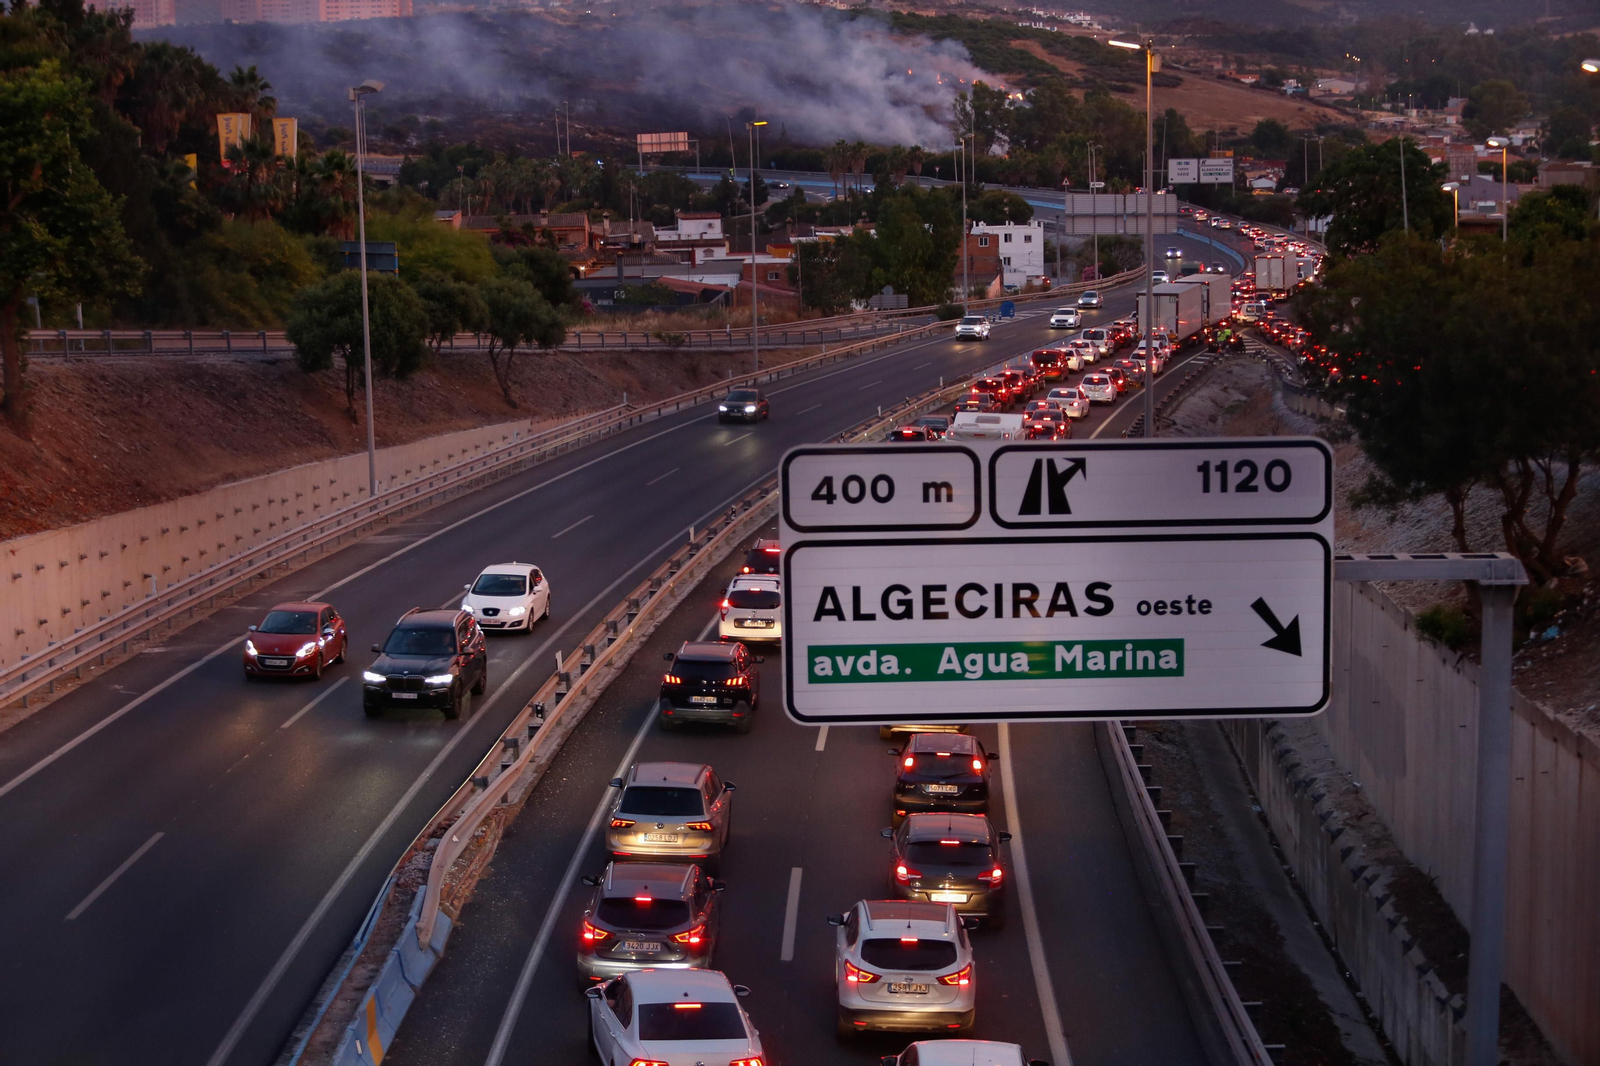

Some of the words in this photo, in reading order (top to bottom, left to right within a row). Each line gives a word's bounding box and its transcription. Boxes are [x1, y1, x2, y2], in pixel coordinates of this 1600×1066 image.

[811, 474, 896, 505] 400
[922, 482, 953, 504] m
[1197, 459, 1292, 494] 1120
[813, 581, 1115, 622] ALGECIRAS
[1137, 594, 1213, 617] oeste
[813, 648, 913, 677] avda.
[936, 646, 1031, 679] Agua
[1053, 642, 1178, 673] Marina
[627, 942, 644, 950] 3420
[646, 942, 660, 950] JJX
[914, 984, 928, 992] JYJ
